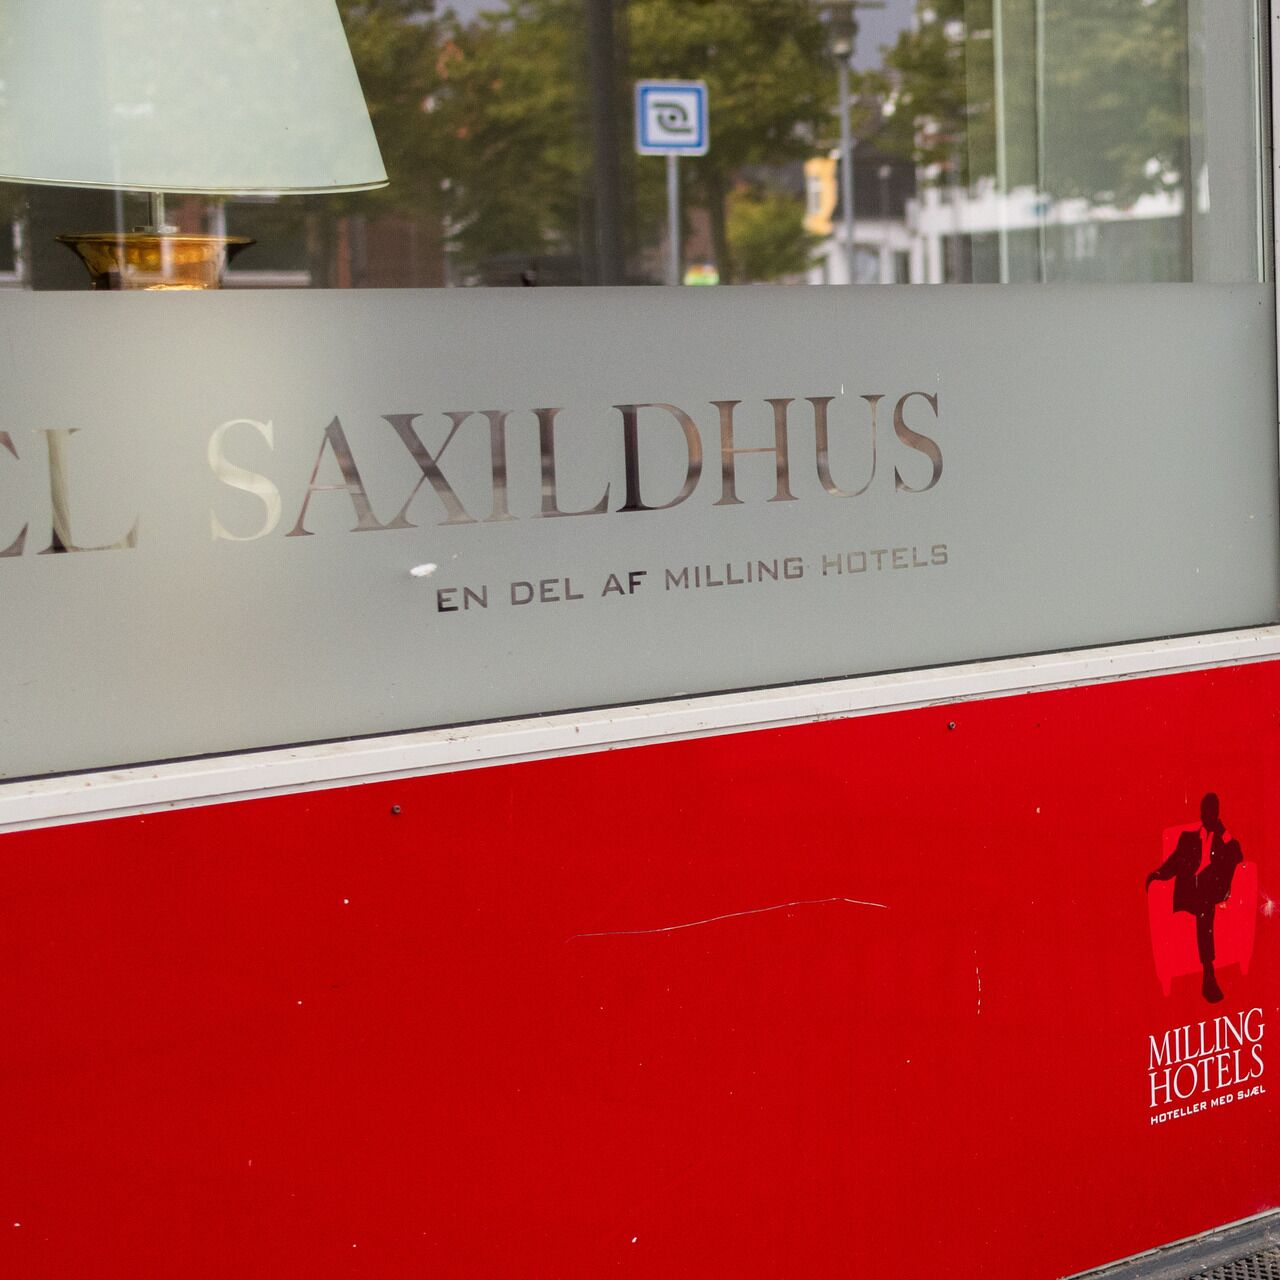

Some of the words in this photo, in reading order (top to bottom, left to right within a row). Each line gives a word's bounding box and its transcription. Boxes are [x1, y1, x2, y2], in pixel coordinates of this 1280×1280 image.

[207, 391, 944, 542] SAXILDHUS
[436, 585, 488, 613] EN
[510, 577, 584, 606] DEL
[601, 570, 648, 597] AF
[664, 556, 804, 591] MILLING
[821, 543, 949, 577] HOTELS
[1148, 1008, 1265, 1070] MILLING
[1149, 1044, 1264, 1107] HOTELS
[1150, 1101, 1207, 1125] HOTELLER
[1211, 1094, 1234, 1107] MED
[1237, 1085, 1266, 1100] SJÆL
